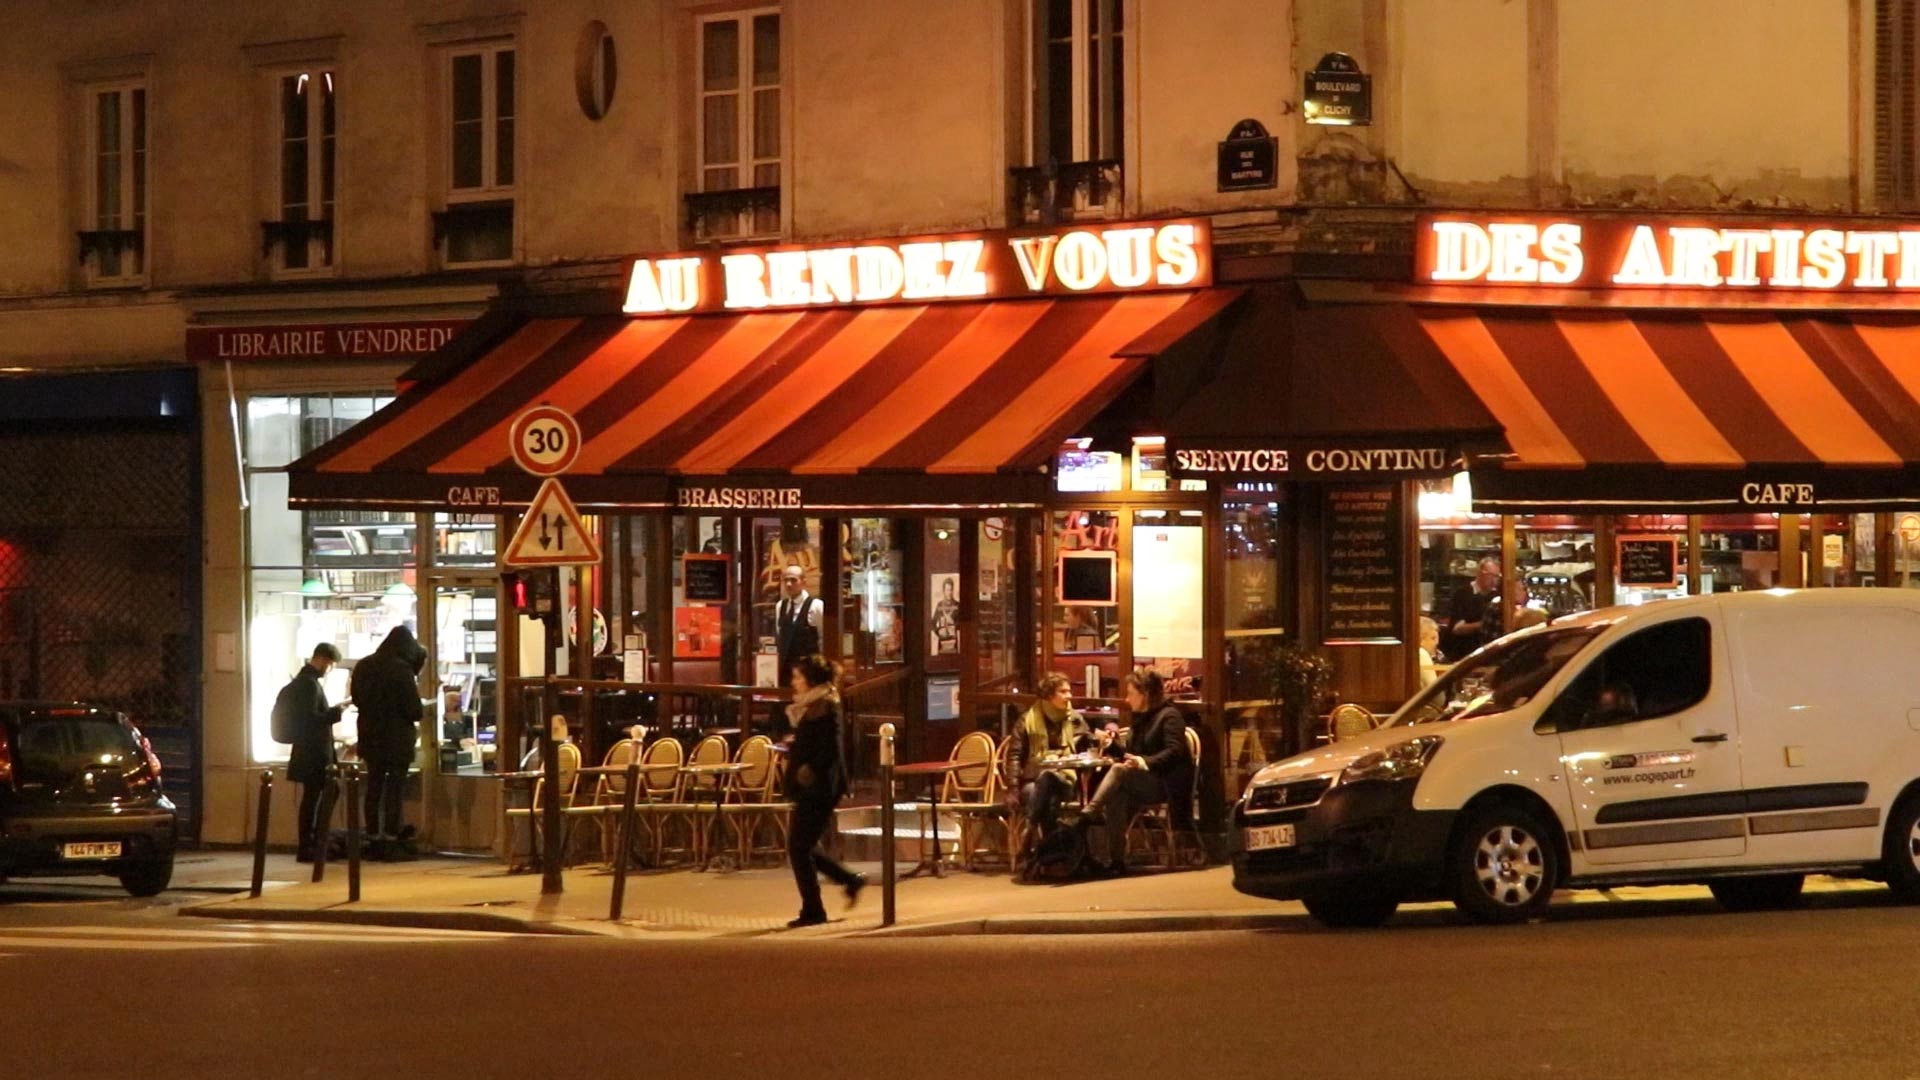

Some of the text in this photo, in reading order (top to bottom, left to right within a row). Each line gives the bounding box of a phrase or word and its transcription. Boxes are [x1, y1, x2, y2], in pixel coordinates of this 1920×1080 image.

[1315, 81, 1361, 92] BOULEVARD
[1324, 105, 1352, 115] CLICHY
[1431, 221, 1583, 284] DES
[622, 224, 1199, 313] AU RENDEZ VOUS
[218, 331, 326, 357] LIBRAIRIE
[528, 427, 564, 454] 30
[1176, 448, 1446, 472] SERVICE CONTINU
[448, 486, 500, 505] CAFE
[677, 487, 801, 509] BRASSERIE
[1743, 483, 1815, 505] CAFE
[1603, 768, 1696, 785] www.cogepart.fr
